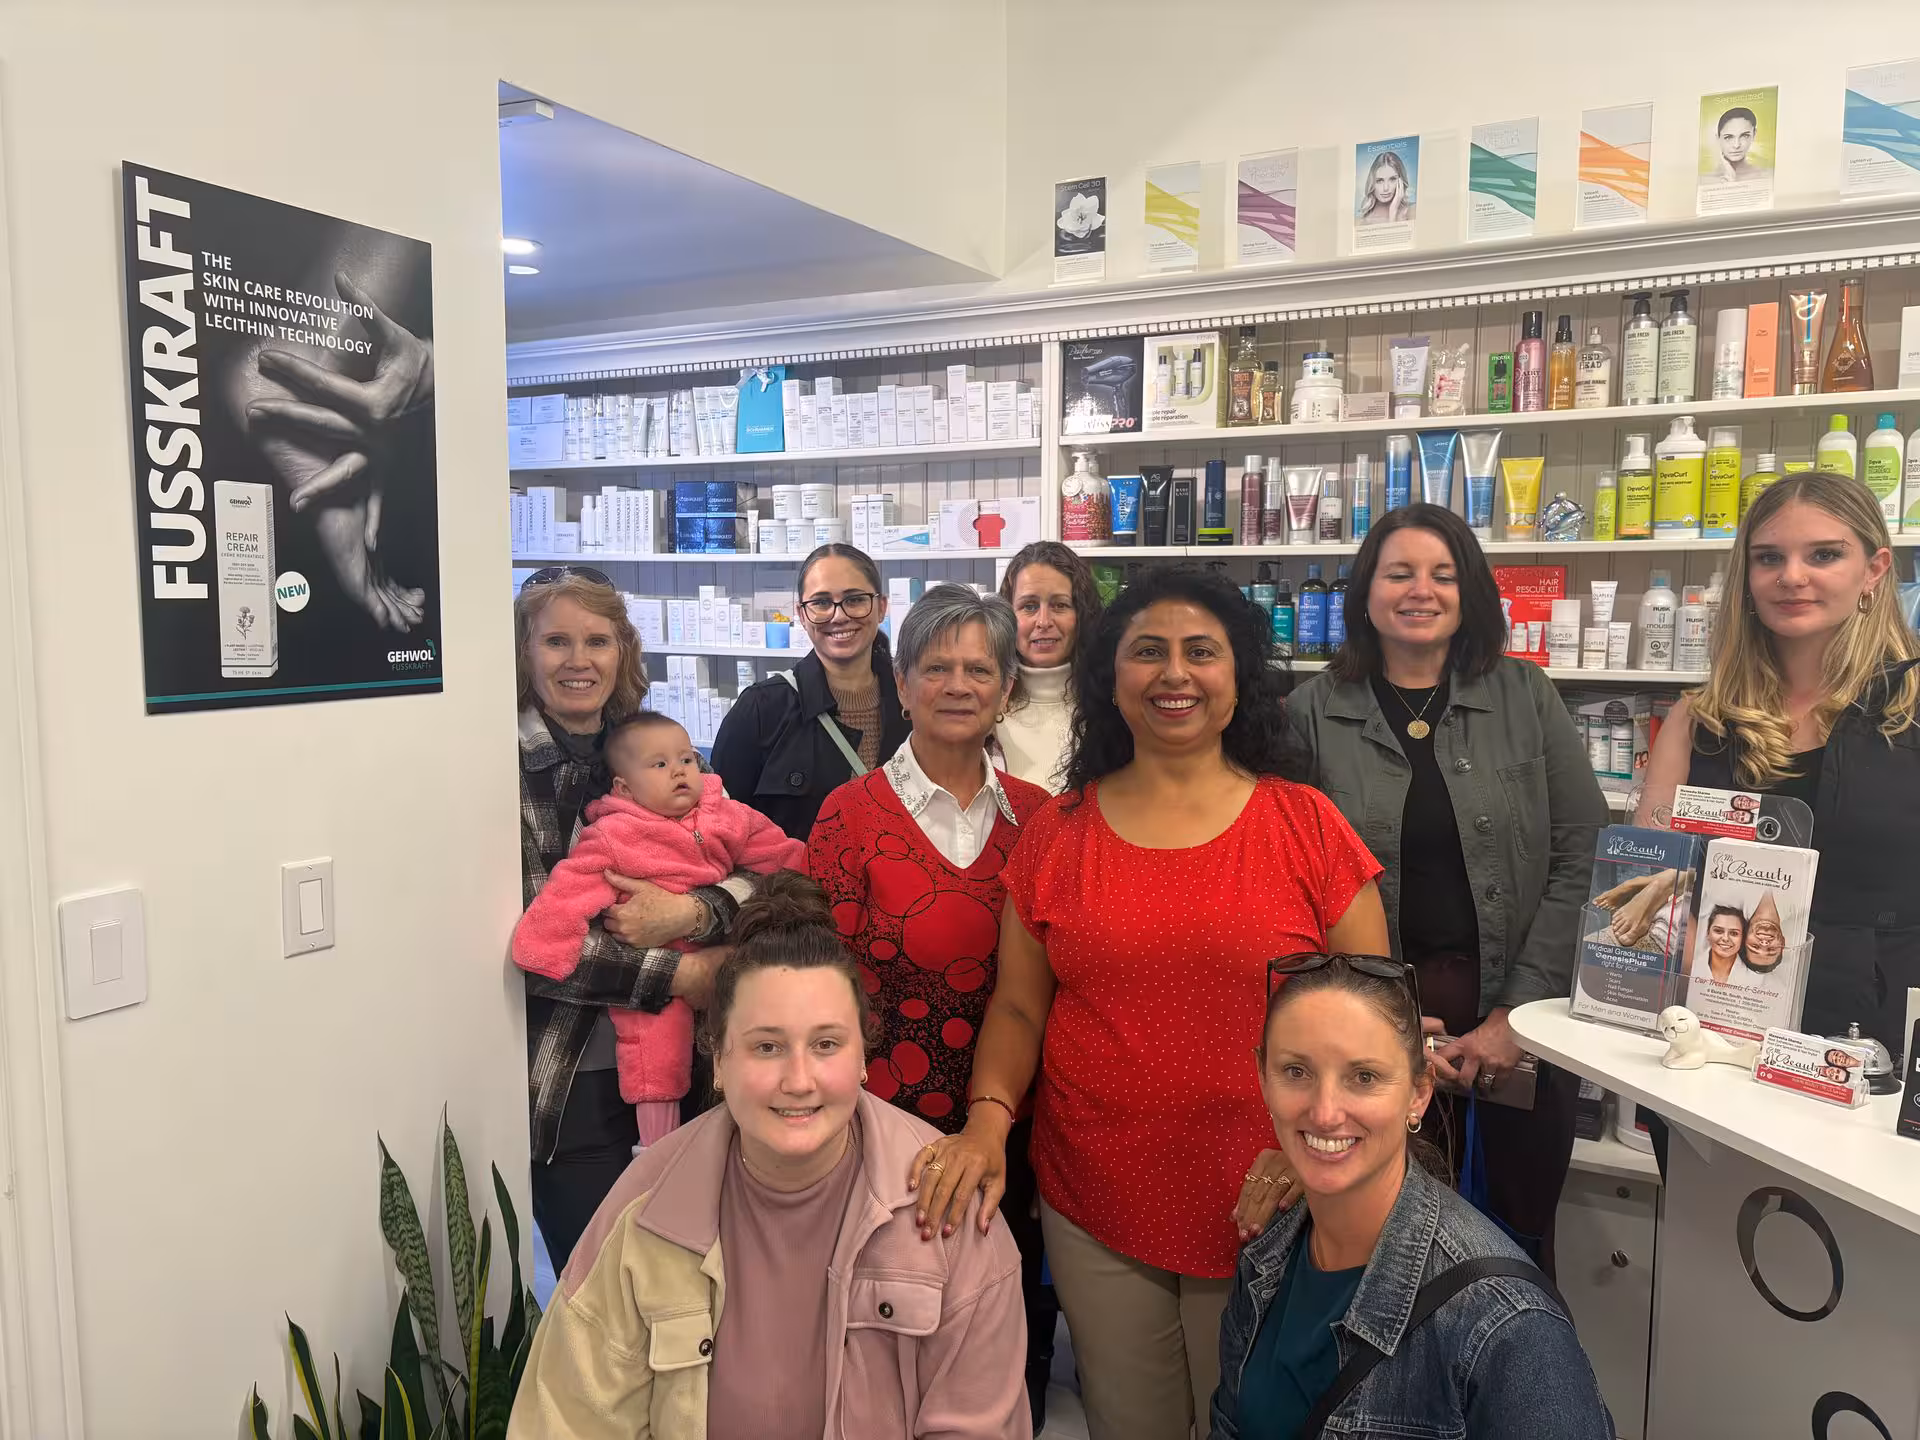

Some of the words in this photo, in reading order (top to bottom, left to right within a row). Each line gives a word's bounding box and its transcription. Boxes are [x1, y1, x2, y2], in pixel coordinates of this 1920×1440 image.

[1367, 141, 1408, 153] Essentials
[201, 251, 232, 271] THE
[203, 272, 240, 293] SKIN
[244, 281, 282, 301] CARE
[286, 289, 374, 320] REVOLUTION
[203, 293, 245, 313] WITH
[250, 303, 338, 331] INNOVATIVE
[205, 312, 275, 338] LECITHIN
[279, 326, 373, 355] TECHNOLOGY
[1579, 361, 1602, 370] HEAD
[1581, 353, 1600, 361] BED
[135, 175, 209, 600] FUSSKRAFT
[1160, 408, 1177, 416] repair
[226, 532, 259, 543] REPAIR
[227, 542, 259, 553] CREAM
[1539, 578, 1559, 586] HAIR
[1547, 585, 1559, 593] KIT
[277, 584, 307, 601] NEW
[387, 649, 434, 663] GEHWOL
[1688, 804, 1730, 823] Beauty
[1619, 840, 1666, 862] Beauty
[1727, 859, 1794, 891] Beauty
[1587, 943, 1614, 953] Medical
[1615, 947, 1636, 958] Grade
[1637, 952, 1658, 962] Laser
[1595, 952, 1648, 967] GenesisPlus
[1617, 985, 1634, 993] Fungal
[1694, 976, 1708, 984] Our
[1709, 978, 1745, 991] Treatments
[1752, 986, 1780, 998] Services
[1590, 1004, 1607, 1012] Men
[1607, 1008, 1622, 1017] and
[1622, 1011, 1652, 1023] Women
[1775, 1053, 1822, 1078] Beauty
